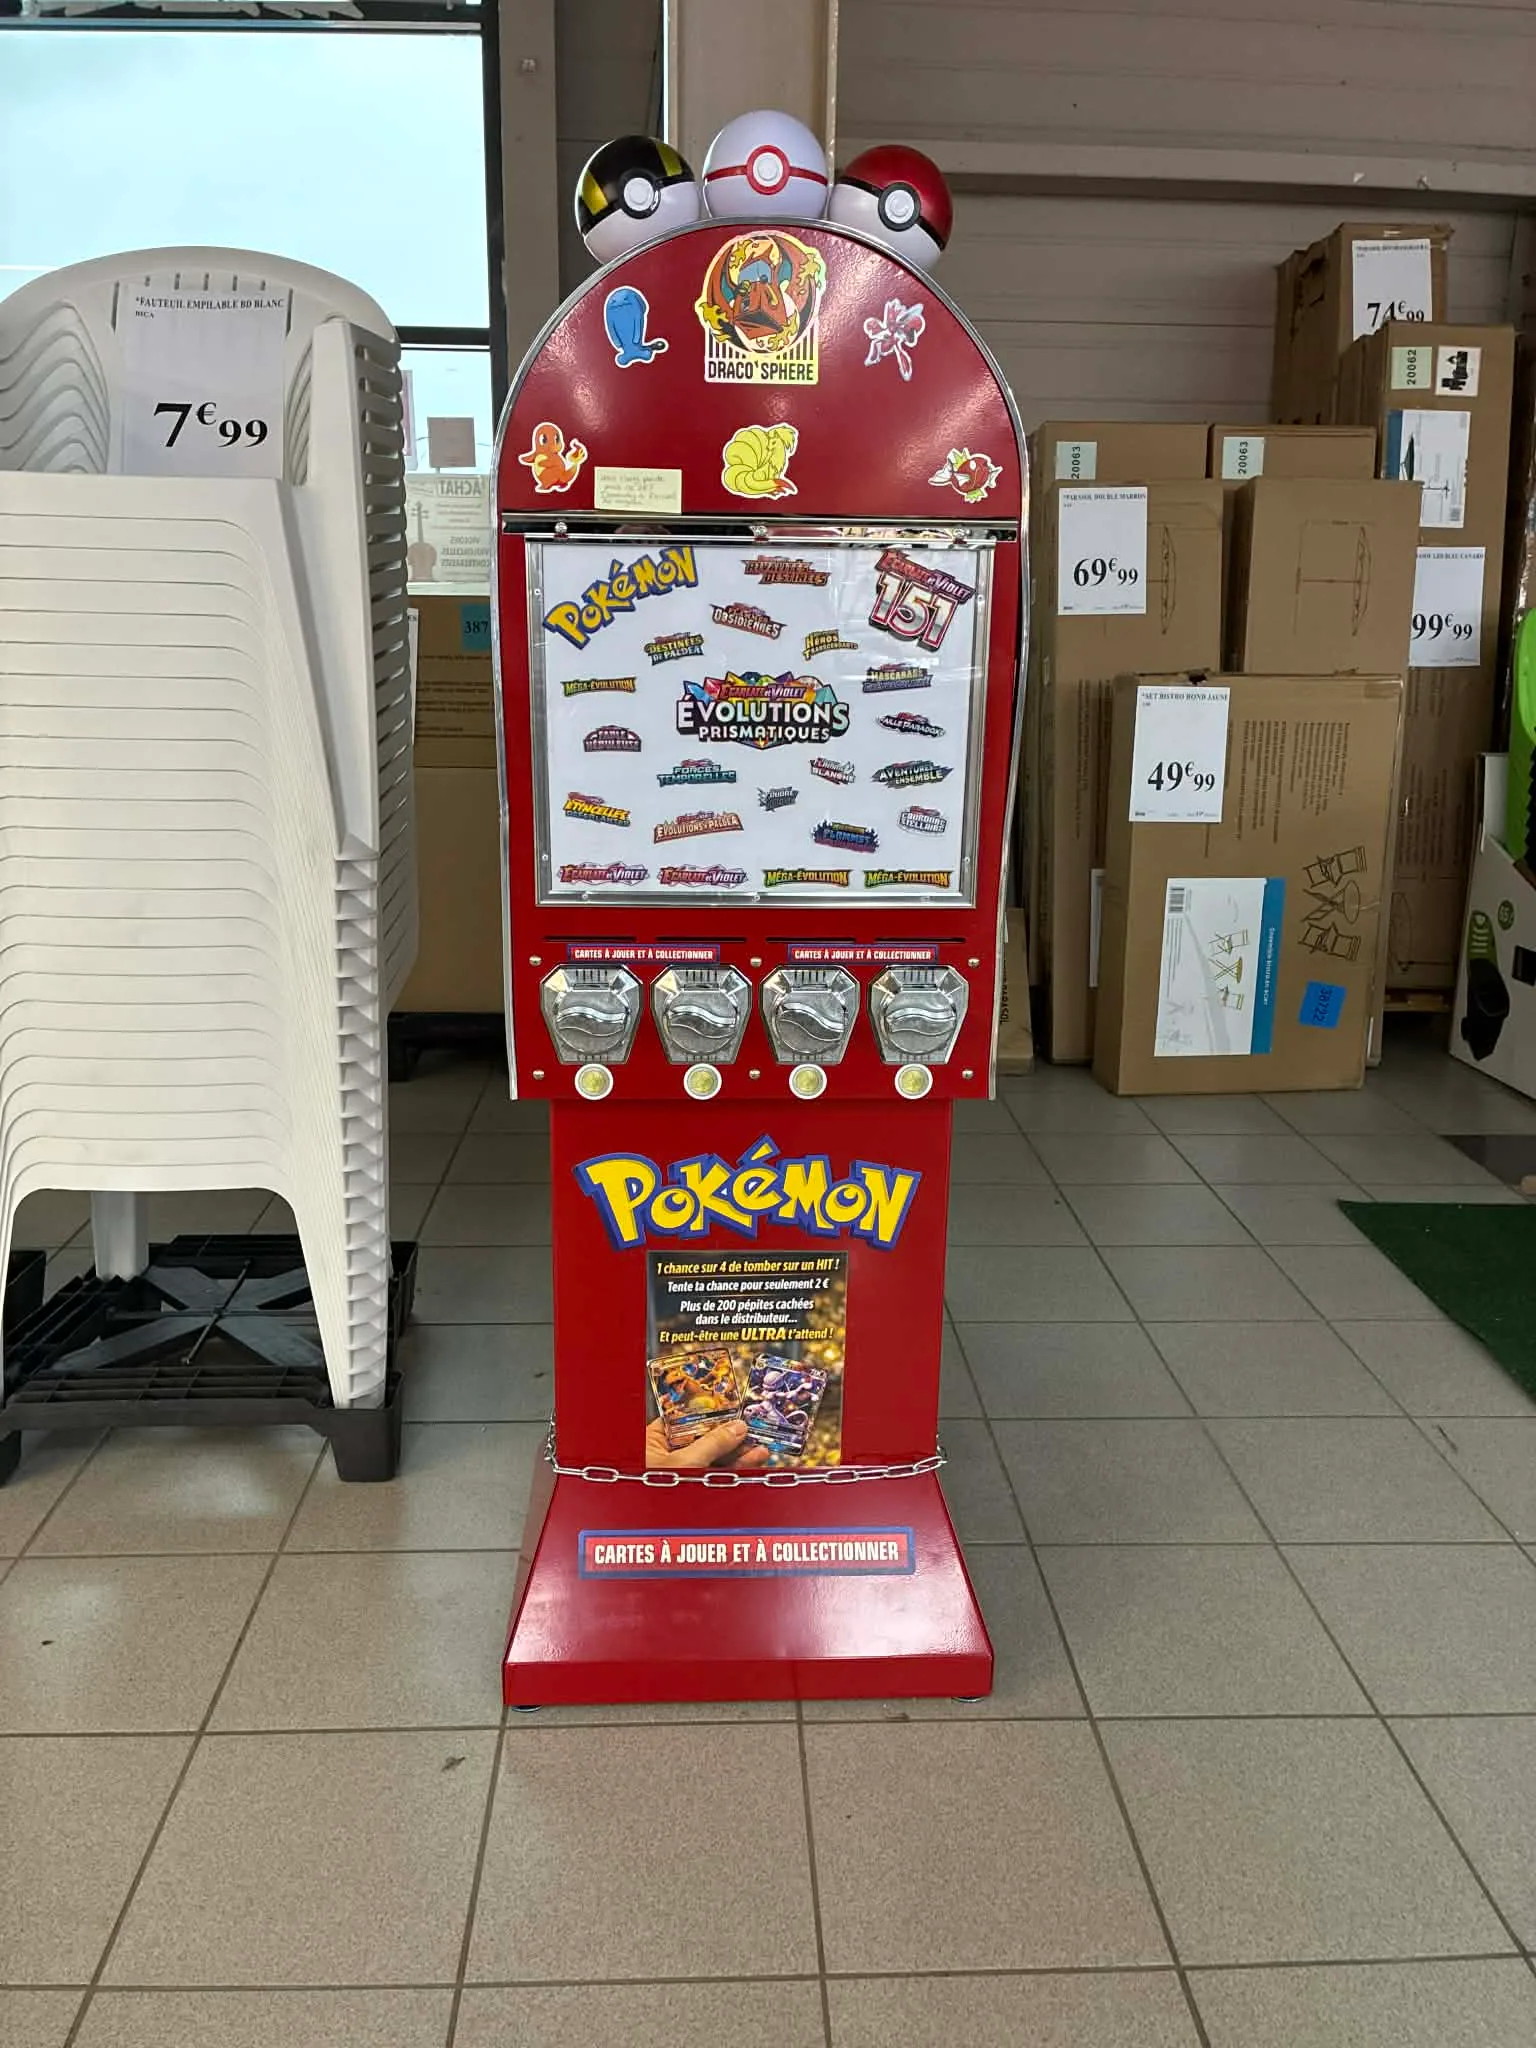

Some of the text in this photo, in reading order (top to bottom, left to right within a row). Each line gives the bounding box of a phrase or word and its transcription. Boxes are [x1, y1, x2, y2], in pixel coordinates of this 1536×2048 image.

[187, 299, 237, 310] EMPILABLE
[241, 299, 252, 309] BD
[254, 298, 285, 309] BLANC
[708, 360, 814, 381] DRACO'SPHERE
[1406, 349, 1418, 386] 20062
[153, 401, 268, 448] 7€99
[1071, 446, 1082, 479] 20063
[1238, 441, 1249, 475] 20063
[1073, 557, 1139, 587] 69€99
[869, 570, 959, 651] 151
[463, 621, 489, 634] 387
[1411, 613, 1473, 640] 99€99
[678, 694, 850, 730] ÉVOLUTIONS
[699, 725, 830, 741] PRISMATIQUES
[1147, 761, 1215, 792] 49€99
[612, 868, 646, 880] VIOLET
[711, 869, 745, 883] VIOLET
[766, 868, 849, 887] MÉGA-ÉVOLUTION
[867, 868, 949, 887] MÉGA-ÉVOLUTION
[574, 948, 713, 960] CARTES À JOUER ET À COLLECTIONNER
[794, 948, 931, 960] CARTES À JOUER ET À COLLECTIONNER
[657, 1262, 663, 1275] 1
[663, 1261, 700, 1274] chance
[700, 1263, 718, 1274] sur
[719, 1261, 727, 1273] 4
[728, 1261, 740, 1273] de
[743, 1260, 781, 1273] tomber
[783, 1262, 799, 1272] sur
[801, 1261, 814, 1271] un
[816, 1258, 834, 1270] HIT
[667, 1278, 830, 1293] Tente ta chance pour seulement 2 €
[680, 1297, 814, 1313] Plus de 200 pépites cachées
[695, 1311, 798, 1325] dans le distributeur...
[659, 1327, 835, 1343] Et peut-être une ULTRA t'attend !
[594, 1539, 899, 1564] CARTES À JOUER ET À COLLECTIONNER
